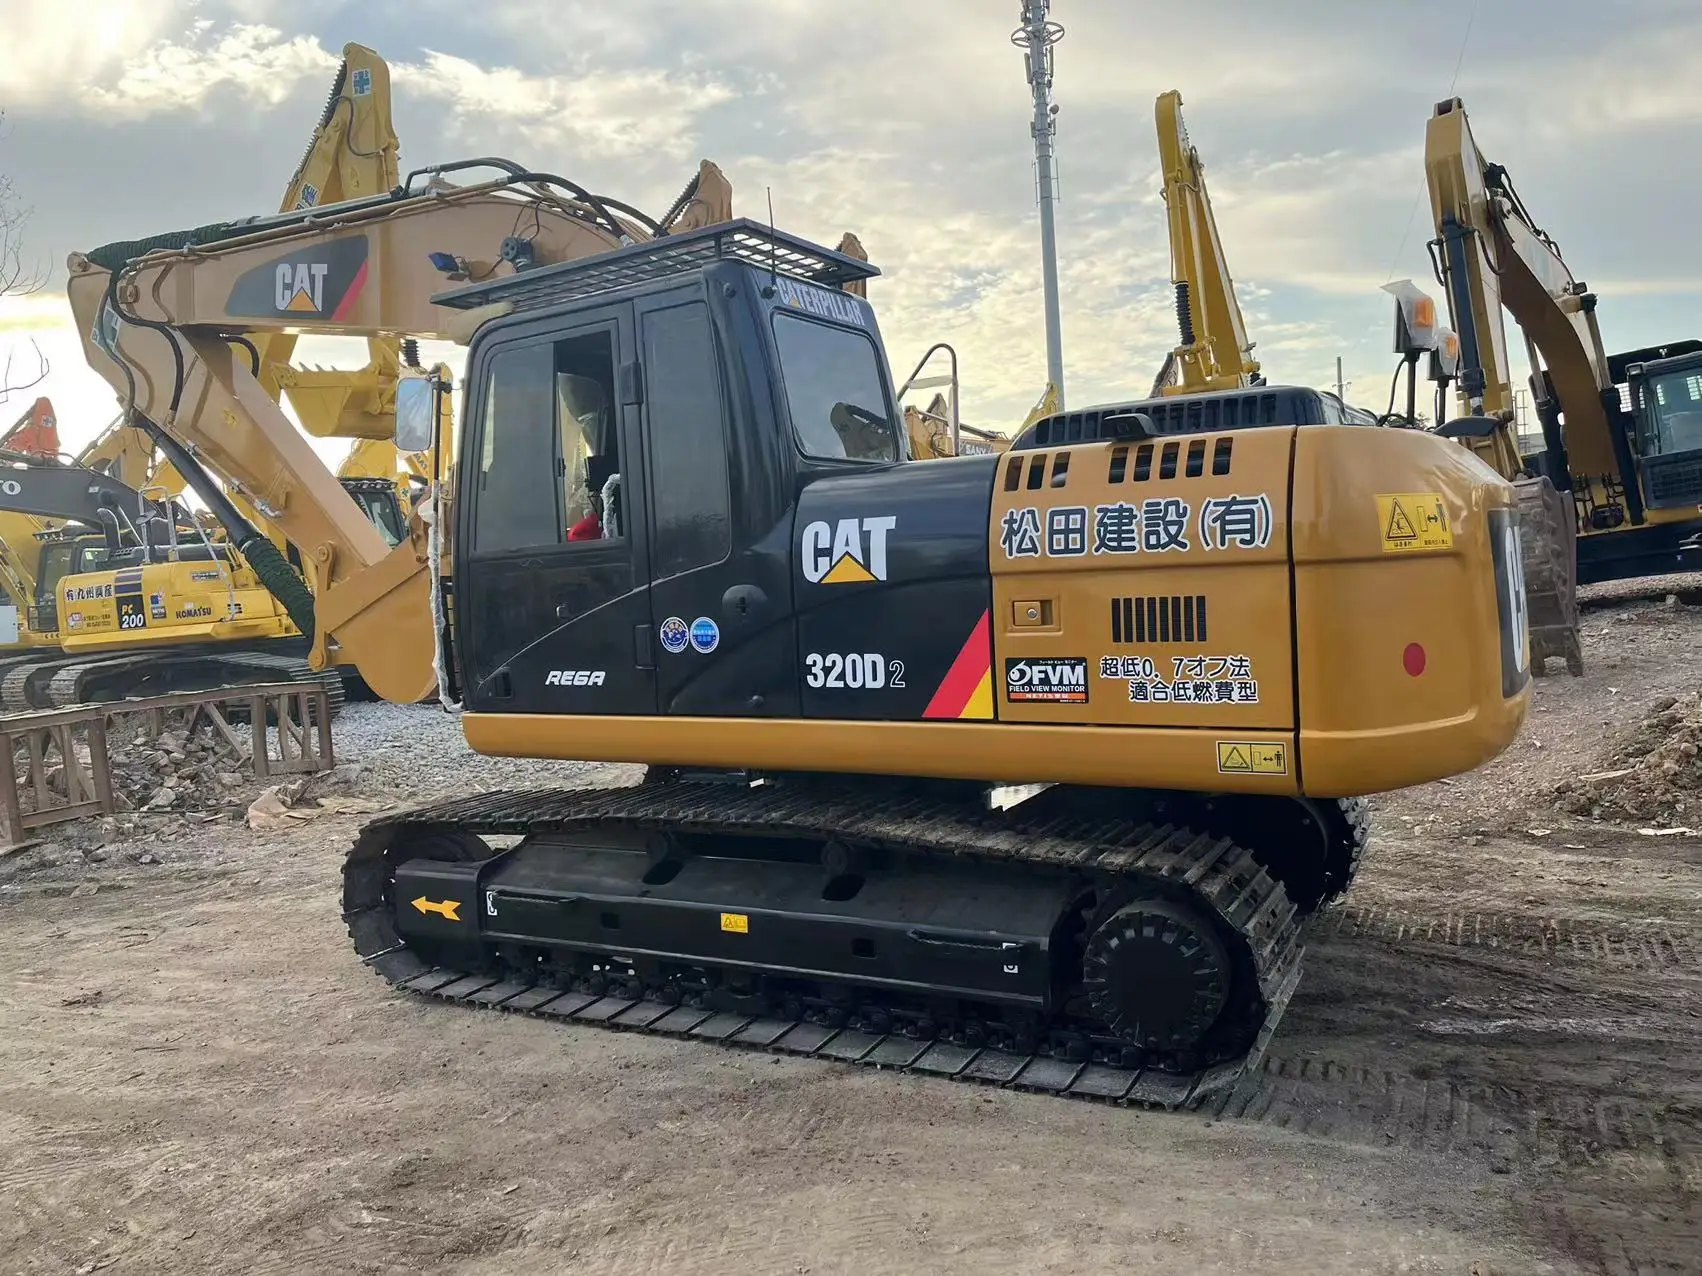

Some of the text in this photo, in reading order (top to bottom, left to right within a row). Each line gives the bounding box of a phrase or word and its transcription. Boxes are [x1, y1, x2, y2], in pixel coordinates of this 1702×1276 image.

[275, 263, 328, 312] CAT
[776, 276, 865, 326] CATERPILLAR
[1000, 495, 1271, 558] 松田建設(有)
[802, 516, 896, 584] CAT
[121, 604, 133, 615] PC
[175, 607, 212, 619] KOMATSU
[121, 613, 144, 629] 200
[545, 670, 606, 686] REGA
[1031, 665, 1085, 685] FVM
[1129, 679, 1258, 702] 適合低燃費型
